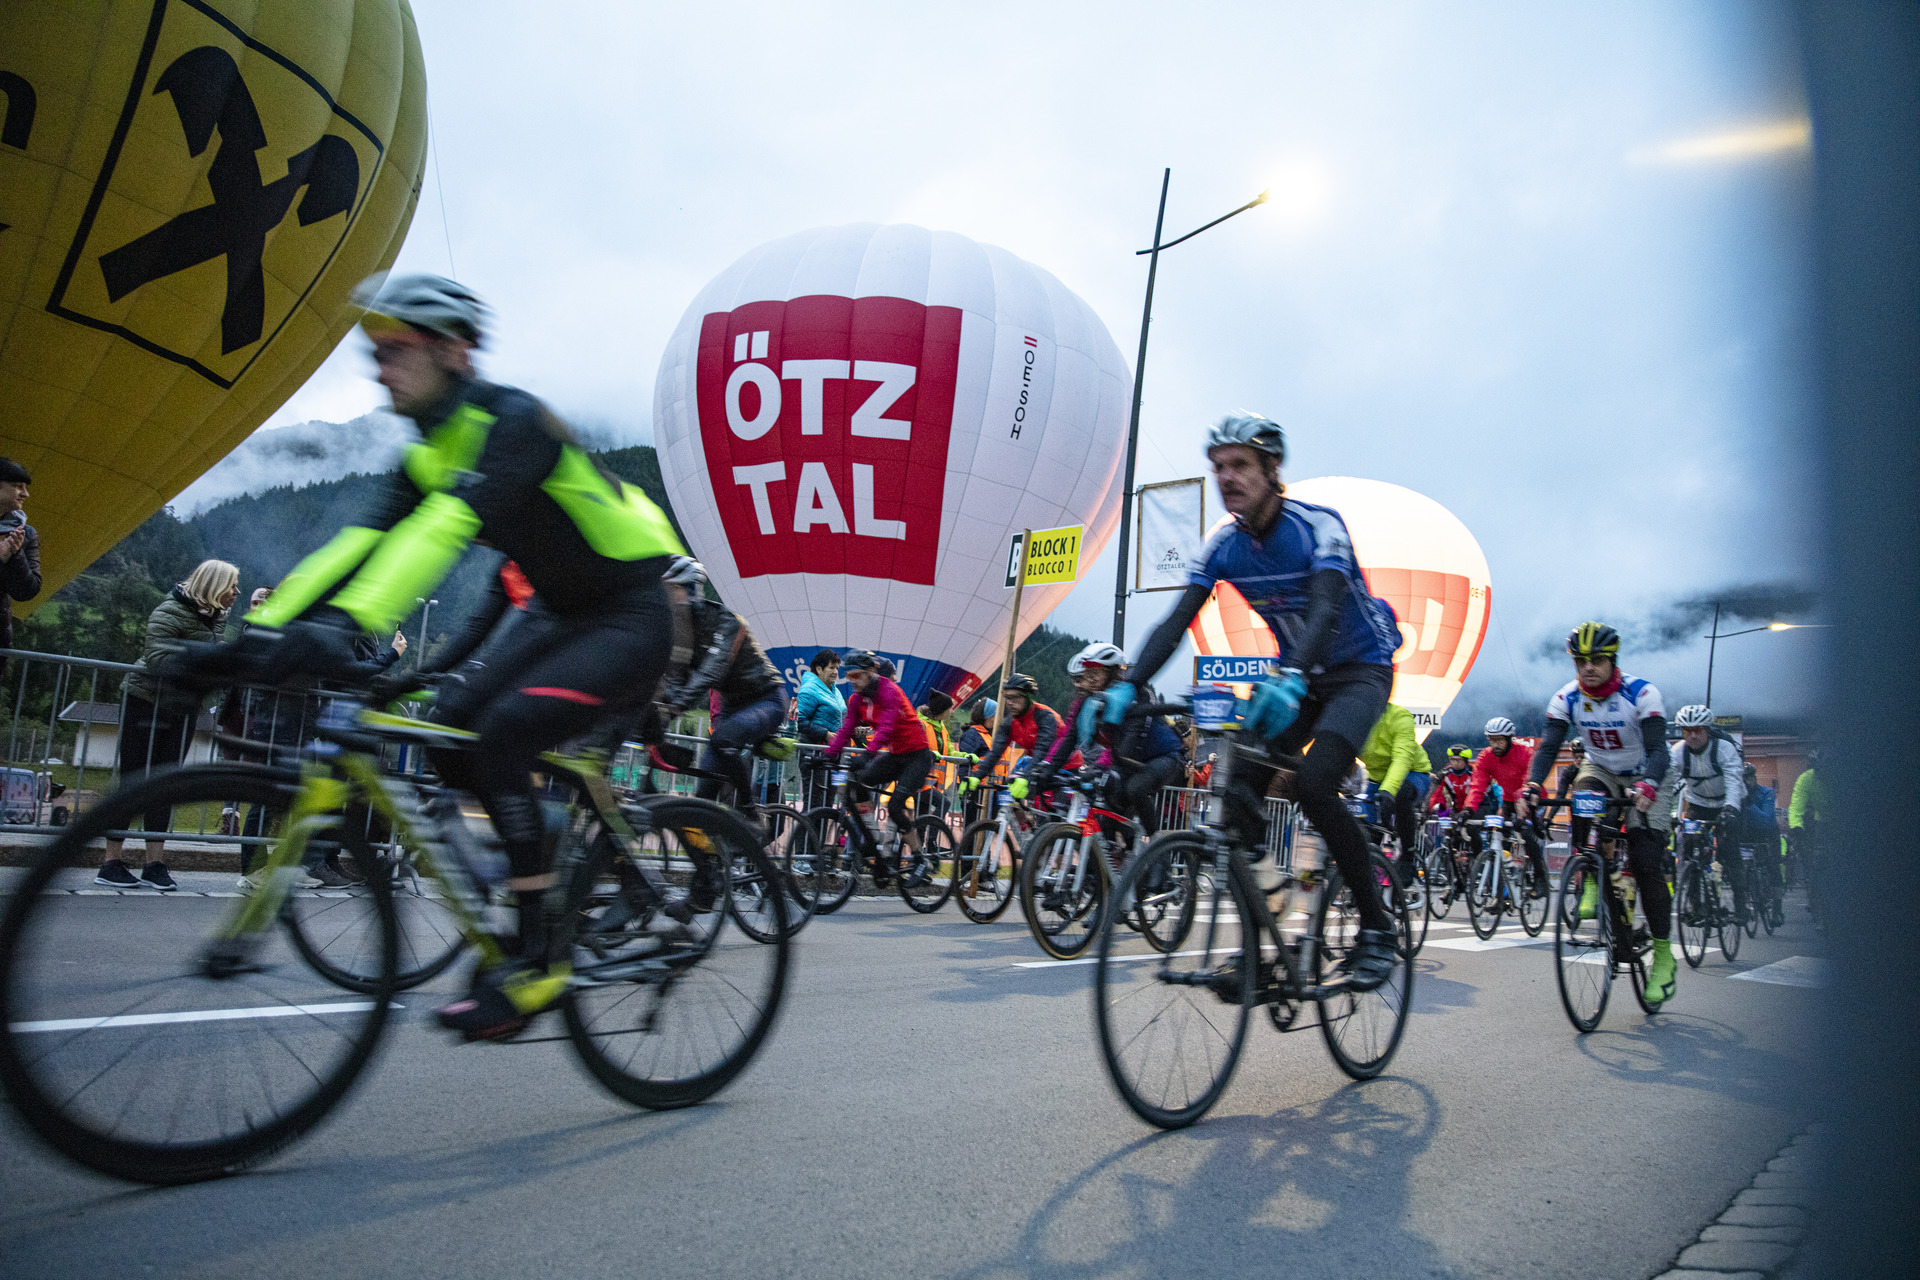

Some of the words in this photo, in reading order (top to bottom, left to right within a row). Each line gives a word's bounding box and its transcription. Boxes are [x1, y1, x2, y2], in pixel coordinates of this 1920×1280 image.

[725, 330, 917, 441] ÖTZ
[1010, 350, 1035, 440] OE-SOH
[732, 460, 907, 541] TAL
[1027, 560, 1065, 576] BLOCCO
[1068, 559, 1073, 573] 1
[1030, 537, 1068, 558] BLOCK
[1070, 536, 1076, 554] 1
[1202, 659, 1273, 679] SÖLDEN
